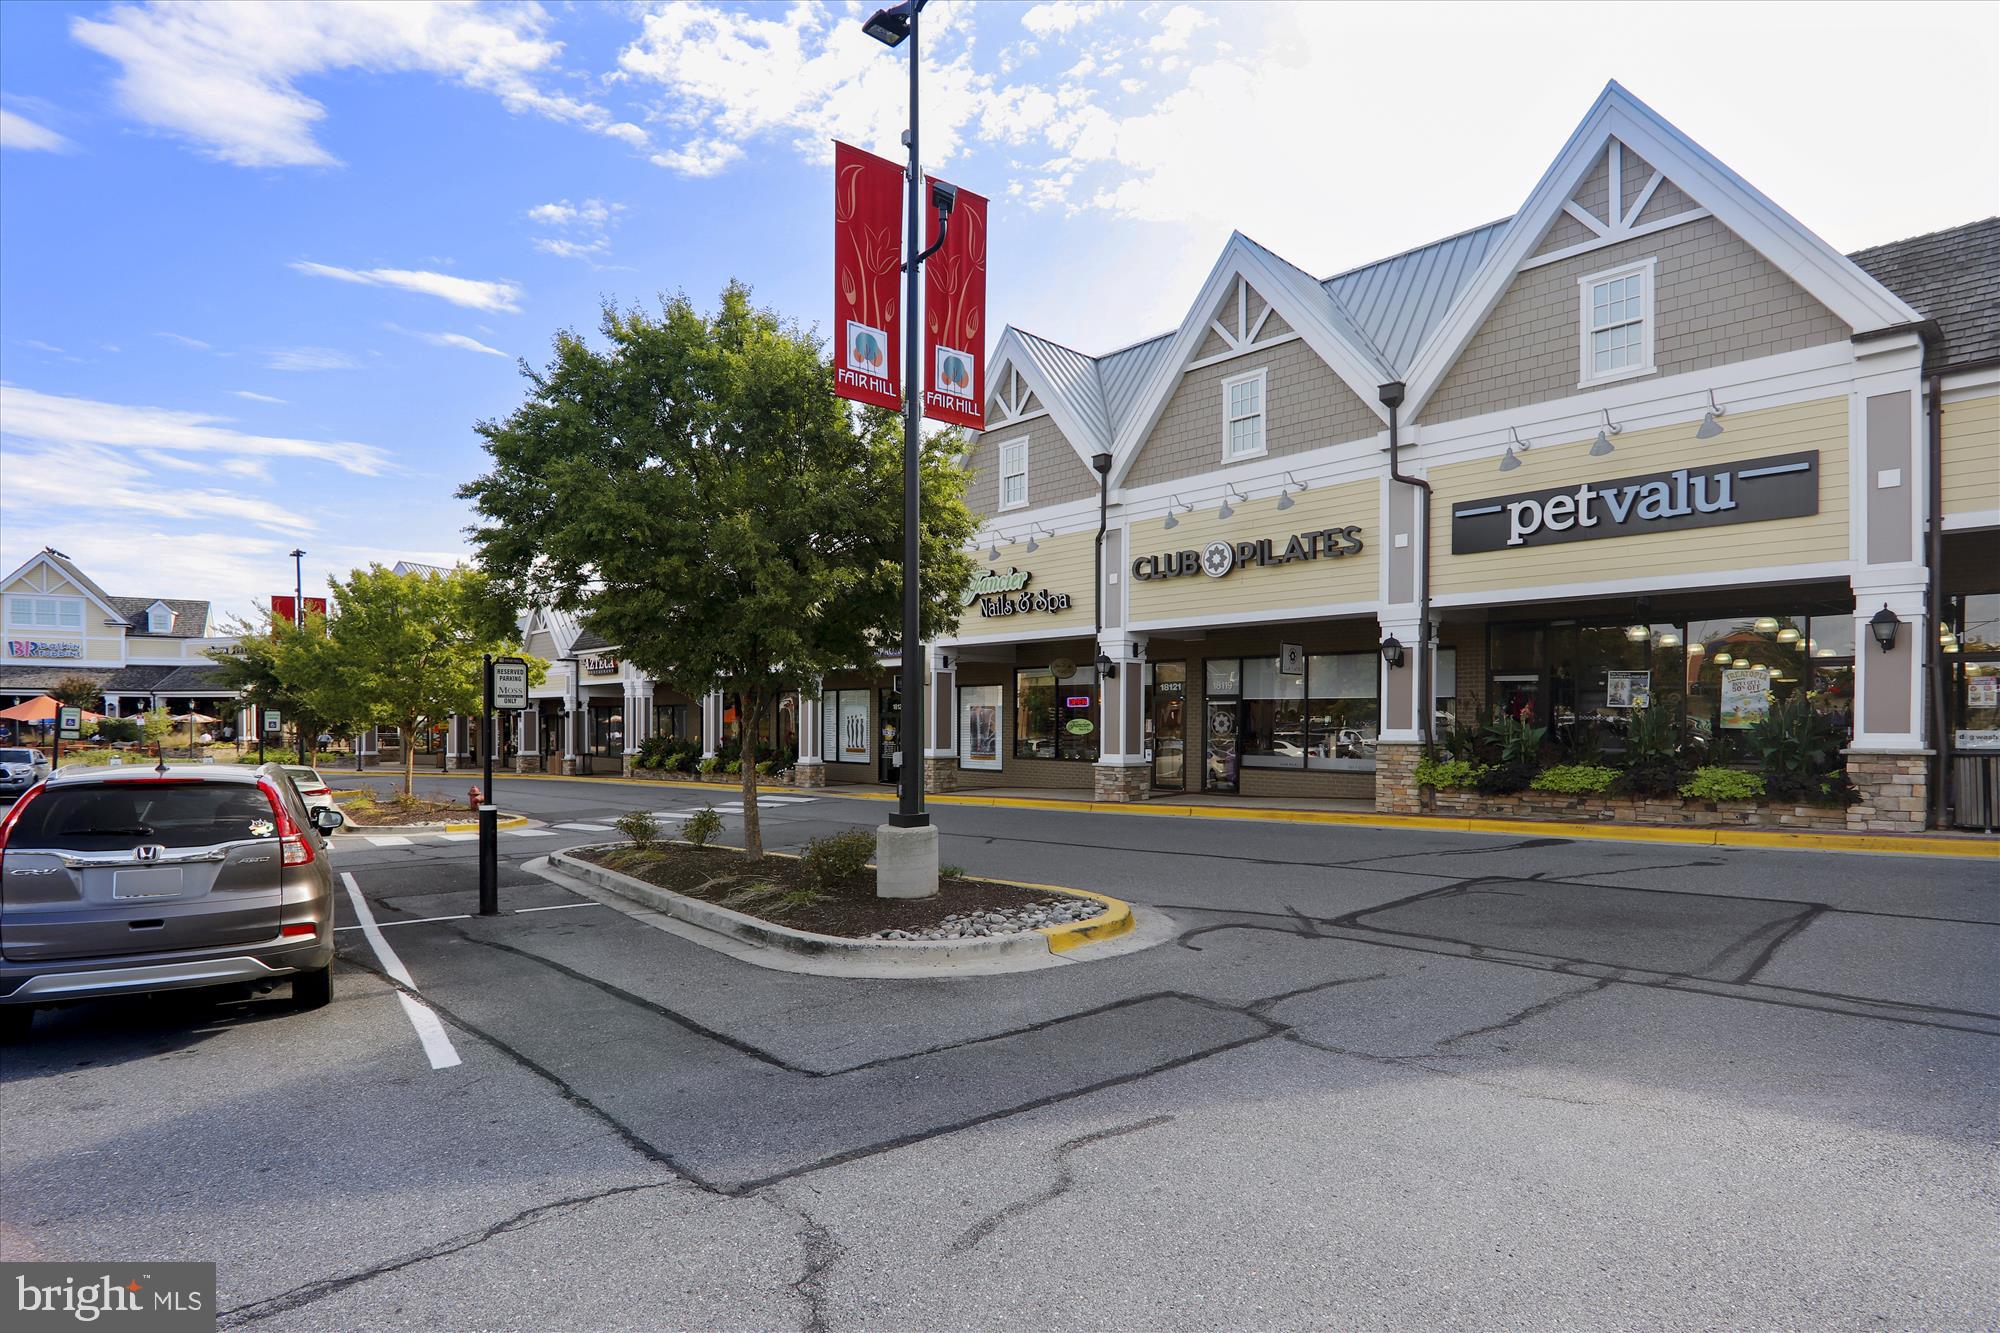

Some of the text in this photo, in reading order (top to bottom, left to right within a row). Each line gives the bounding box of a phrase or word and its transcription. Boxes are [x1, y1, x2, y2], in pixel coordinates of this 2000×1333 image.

[838, 368, 897, 398] FAIR HILL
[926, 391, 981, 417] FAIR HILL
[1132, 525, 1364, 581] CLUB PILATES
[961, 566, 1030, 606] Fancier
[980, 588, 1071, 617] Nails & Spa
[8, 640, 38, 657] BR
[585, 657, 615, 669] AZTECA
[1160, 683, 1182, 691] 18121
